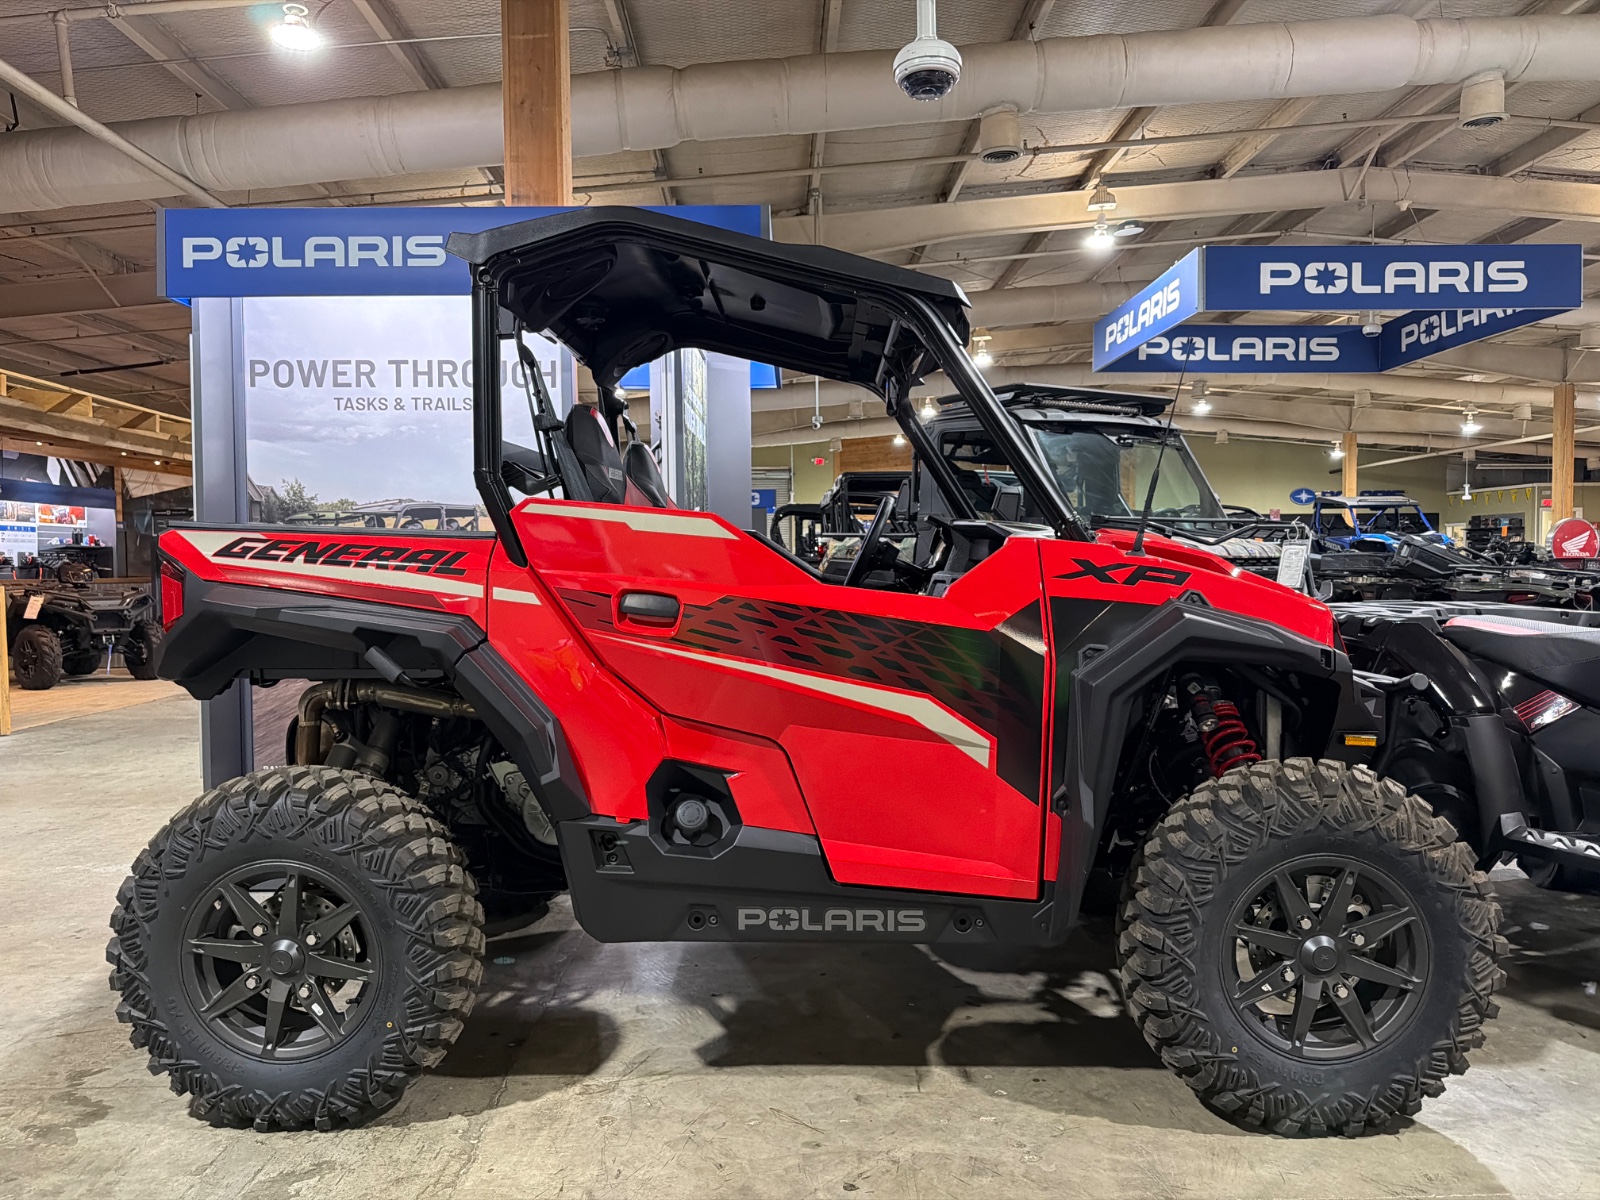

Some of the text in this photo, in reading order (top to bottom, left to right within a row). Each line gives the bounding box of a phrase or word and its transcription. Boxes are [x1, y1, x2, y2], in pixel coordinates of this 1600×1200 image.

[182, 236, 446, 268] POLARIS
[1260, 260, 1528, 294] POLARIS
[1104, 278, 1180, 352] POLARIS
[1138, 336, 1340, 361] POLARIS
[249, 359, 376, 389] POWER
[333, 397, 473, 412] TASKS & TRAILS
[210, 536, 469, 576] GENERAL
[1050, 557, 1193, 587] XP
[738, 908, 926, 932] POLARIS
